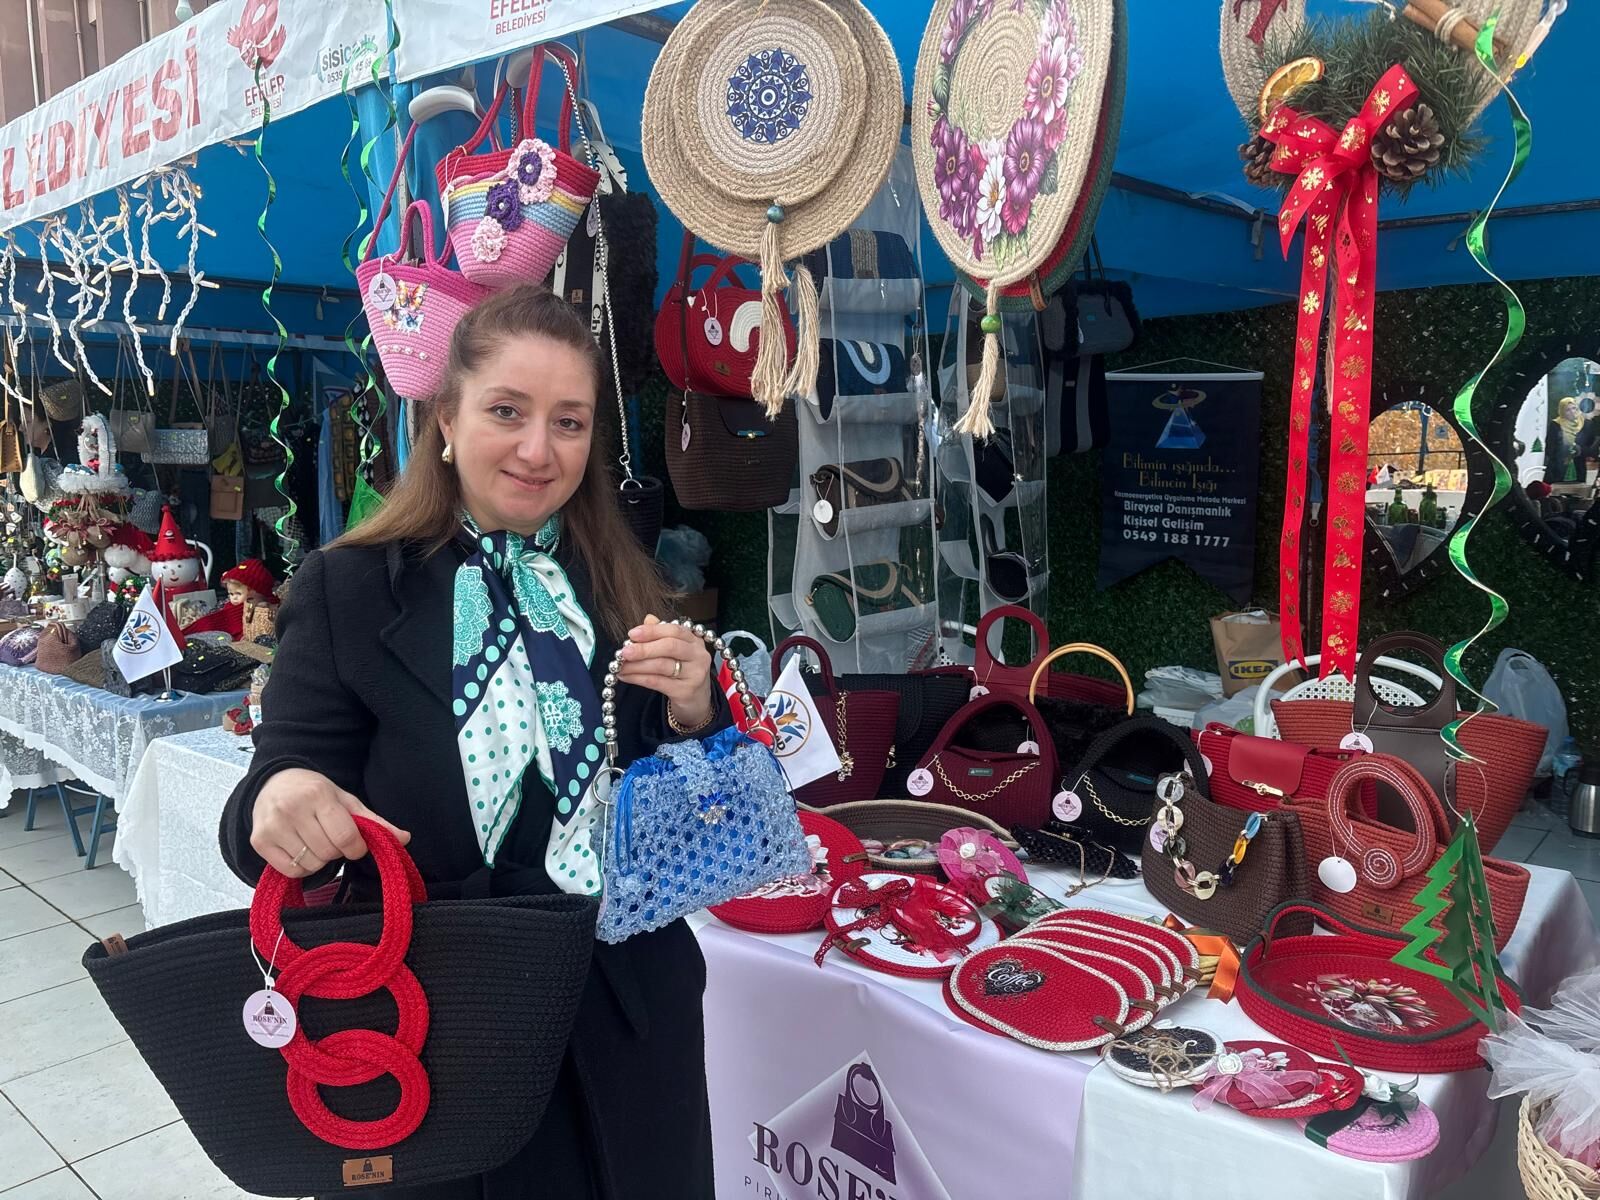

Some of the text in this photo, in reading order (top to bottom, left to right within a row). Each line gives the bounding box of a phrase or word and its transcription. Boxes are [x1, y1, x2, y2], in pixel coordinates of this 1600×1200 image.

[495, 6, 546, 35] BELEDİYESİ
[1123, 452, 1167, 470] Bilimin
[1139, 471, 1187, 489] Bilincin
[1124, 500, 1232, 518] Bireysel Danışmanlık
[1123, 514, 1204, 533] Kişisel Gelişim
[1123, 528, 1231, 548] 0549 188 1777
[1234, 665, 1273, 674] IKEA
[988, 965, 1041, 992] Coffee
[252, 1014, 288, 1025] ROSE'NIN
